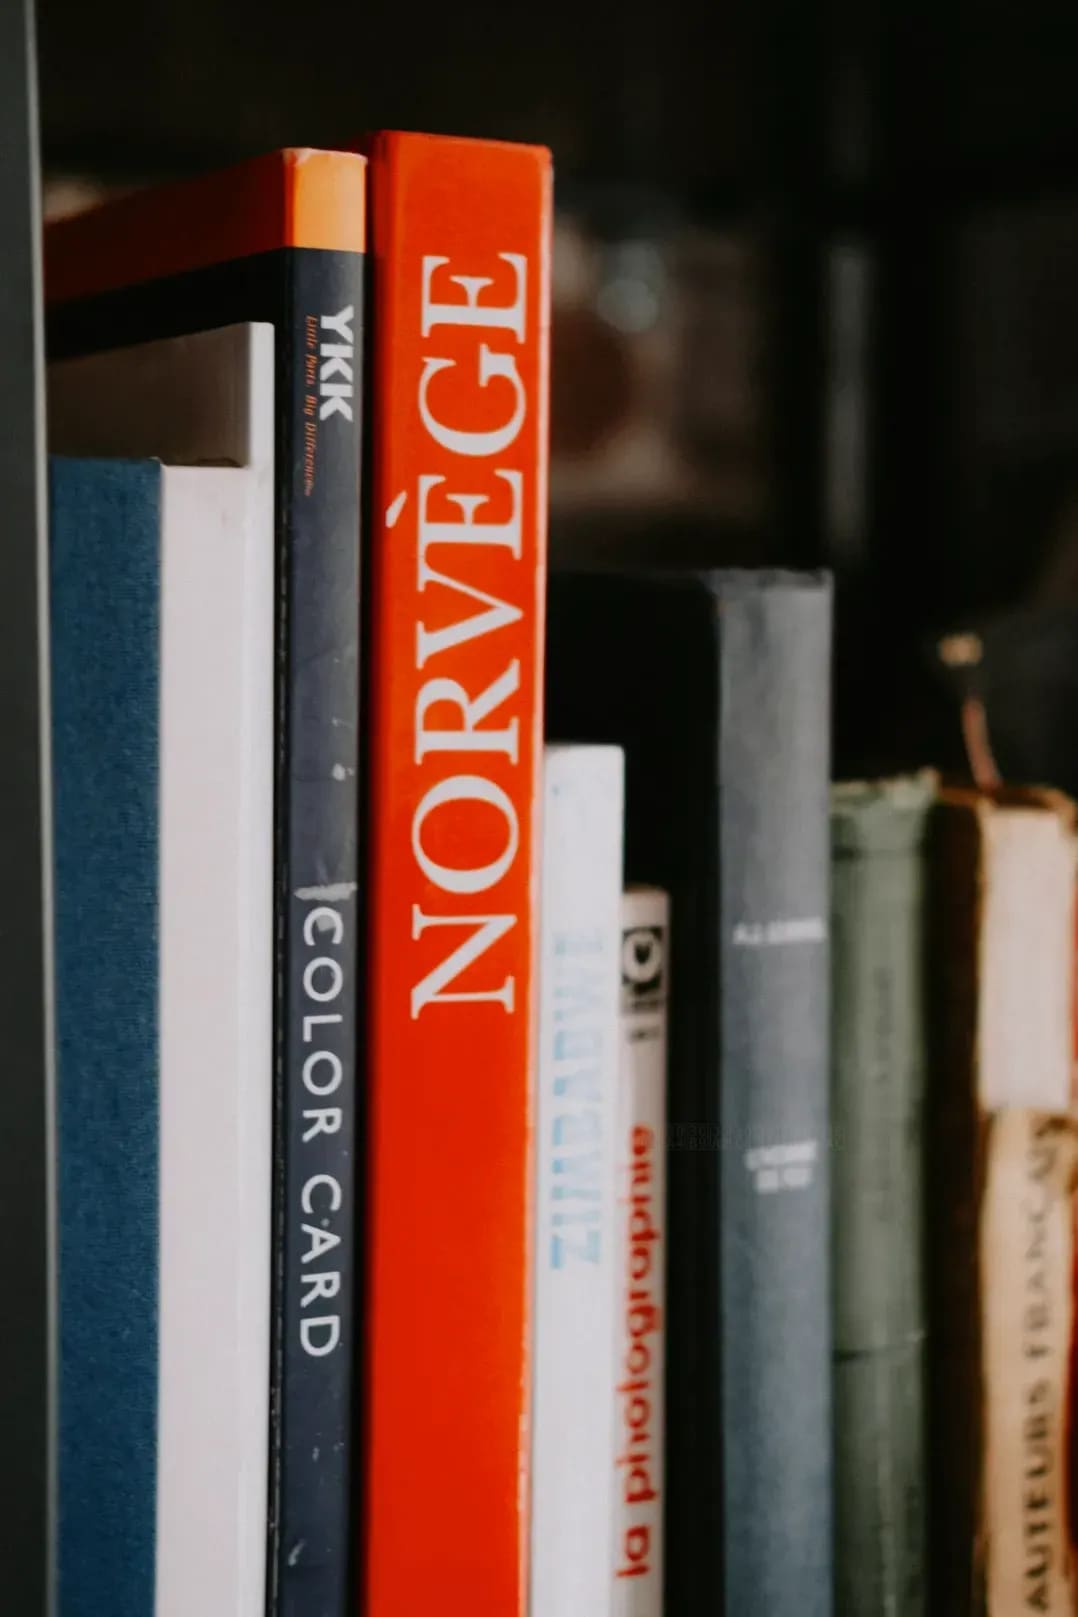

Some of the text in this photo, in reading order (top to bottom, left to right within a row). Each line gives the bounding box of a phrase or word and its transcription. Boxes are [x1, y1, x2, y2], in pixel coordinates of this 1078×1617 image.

[304, 394, 318, 416] Big
[319, 304, 354, 421] YKK
[386, 252, 528, 1020] NORVÈGE
[300, 906, 343, 1358] COLOR CARD
[616, 1525, 650, 1577] la
